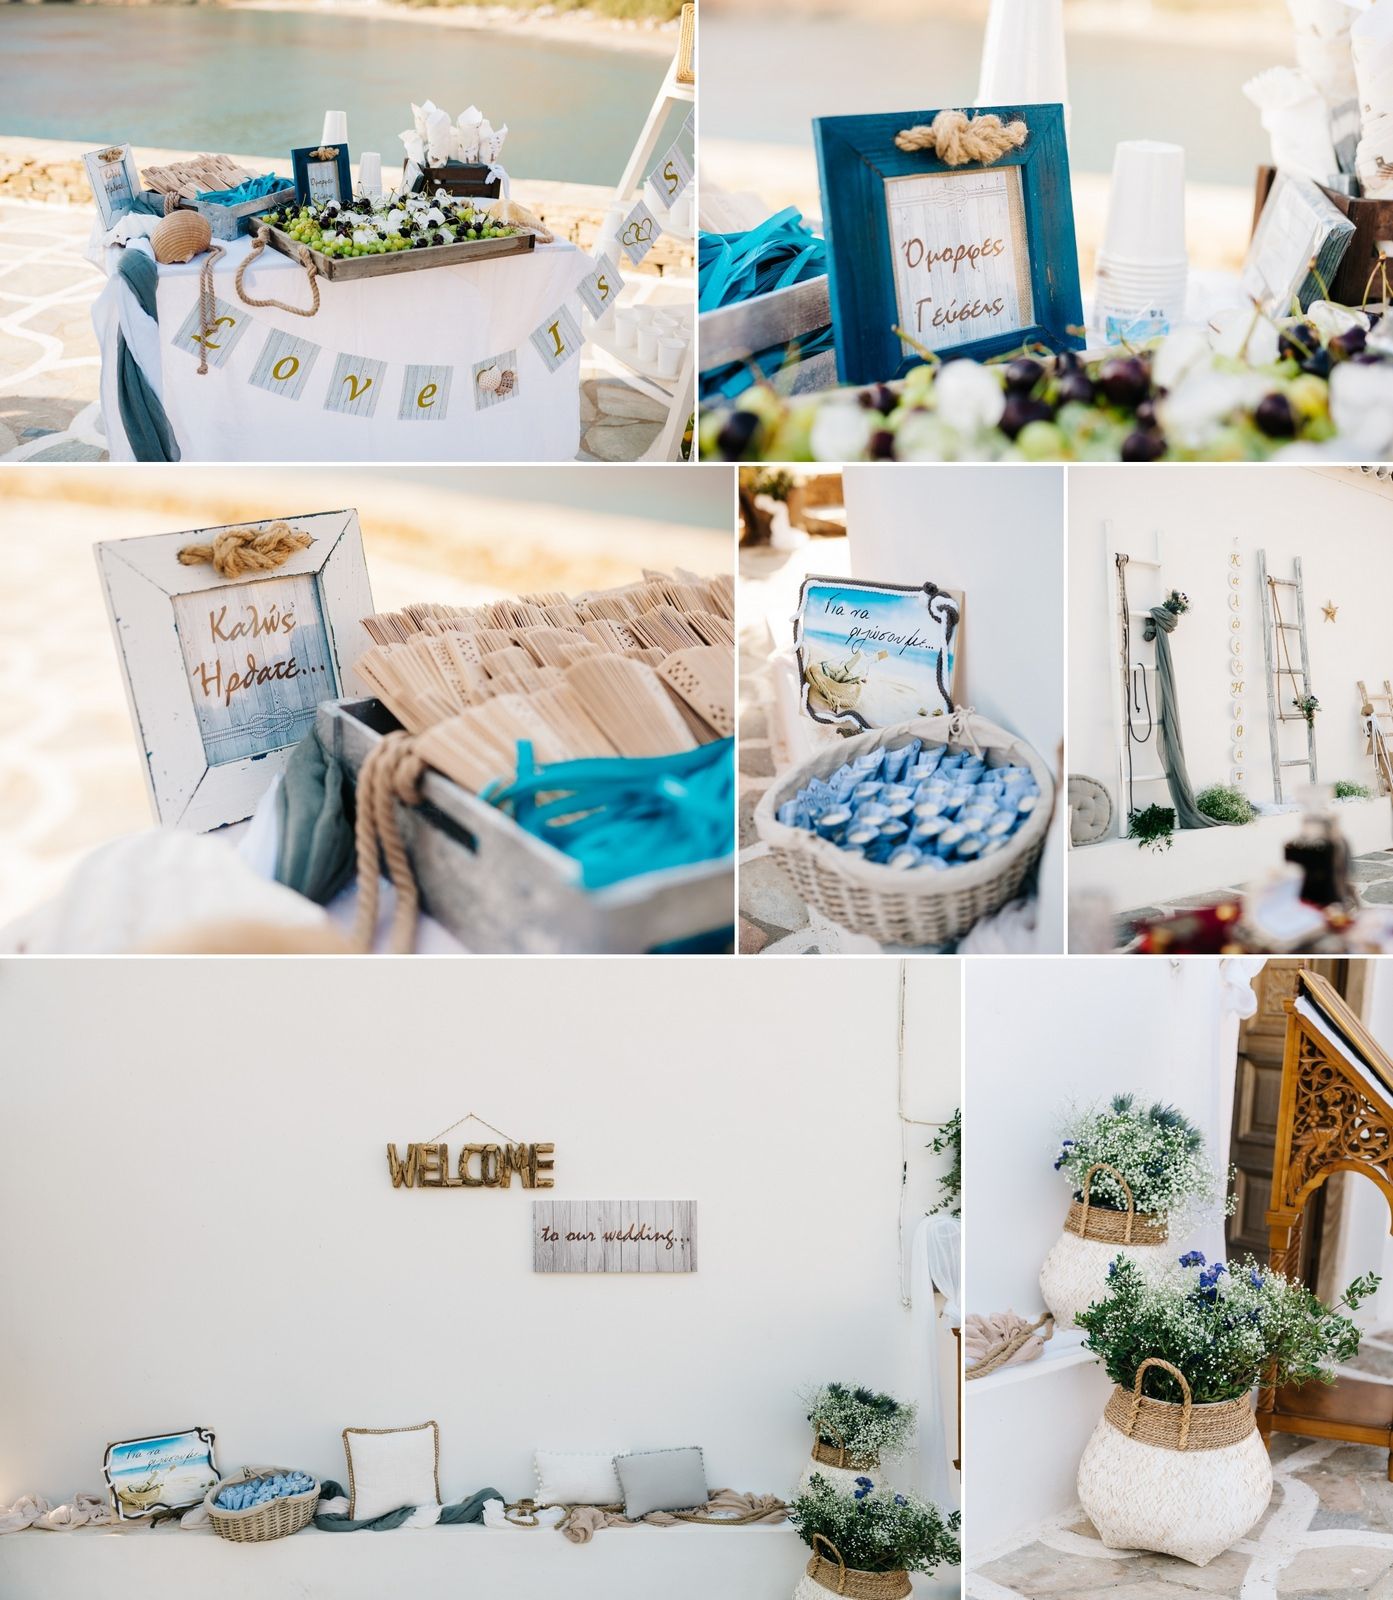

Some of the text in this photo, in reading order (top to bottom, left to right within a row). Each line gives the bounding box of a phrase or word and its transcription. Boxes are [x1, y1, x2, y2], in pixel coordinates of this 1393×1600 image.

[899, 236, 1005, 274] Όμορφες
[914, 296, 1005, 333] Γεύσεις
[208, 603, 297, 645] Καλώς
[824, 592, 870, 620] Για να
[386, 1141, 556, 1190] WELCOME
[540, 1225, 560, 1243] to
[565, 1230, 597, 1243] our
